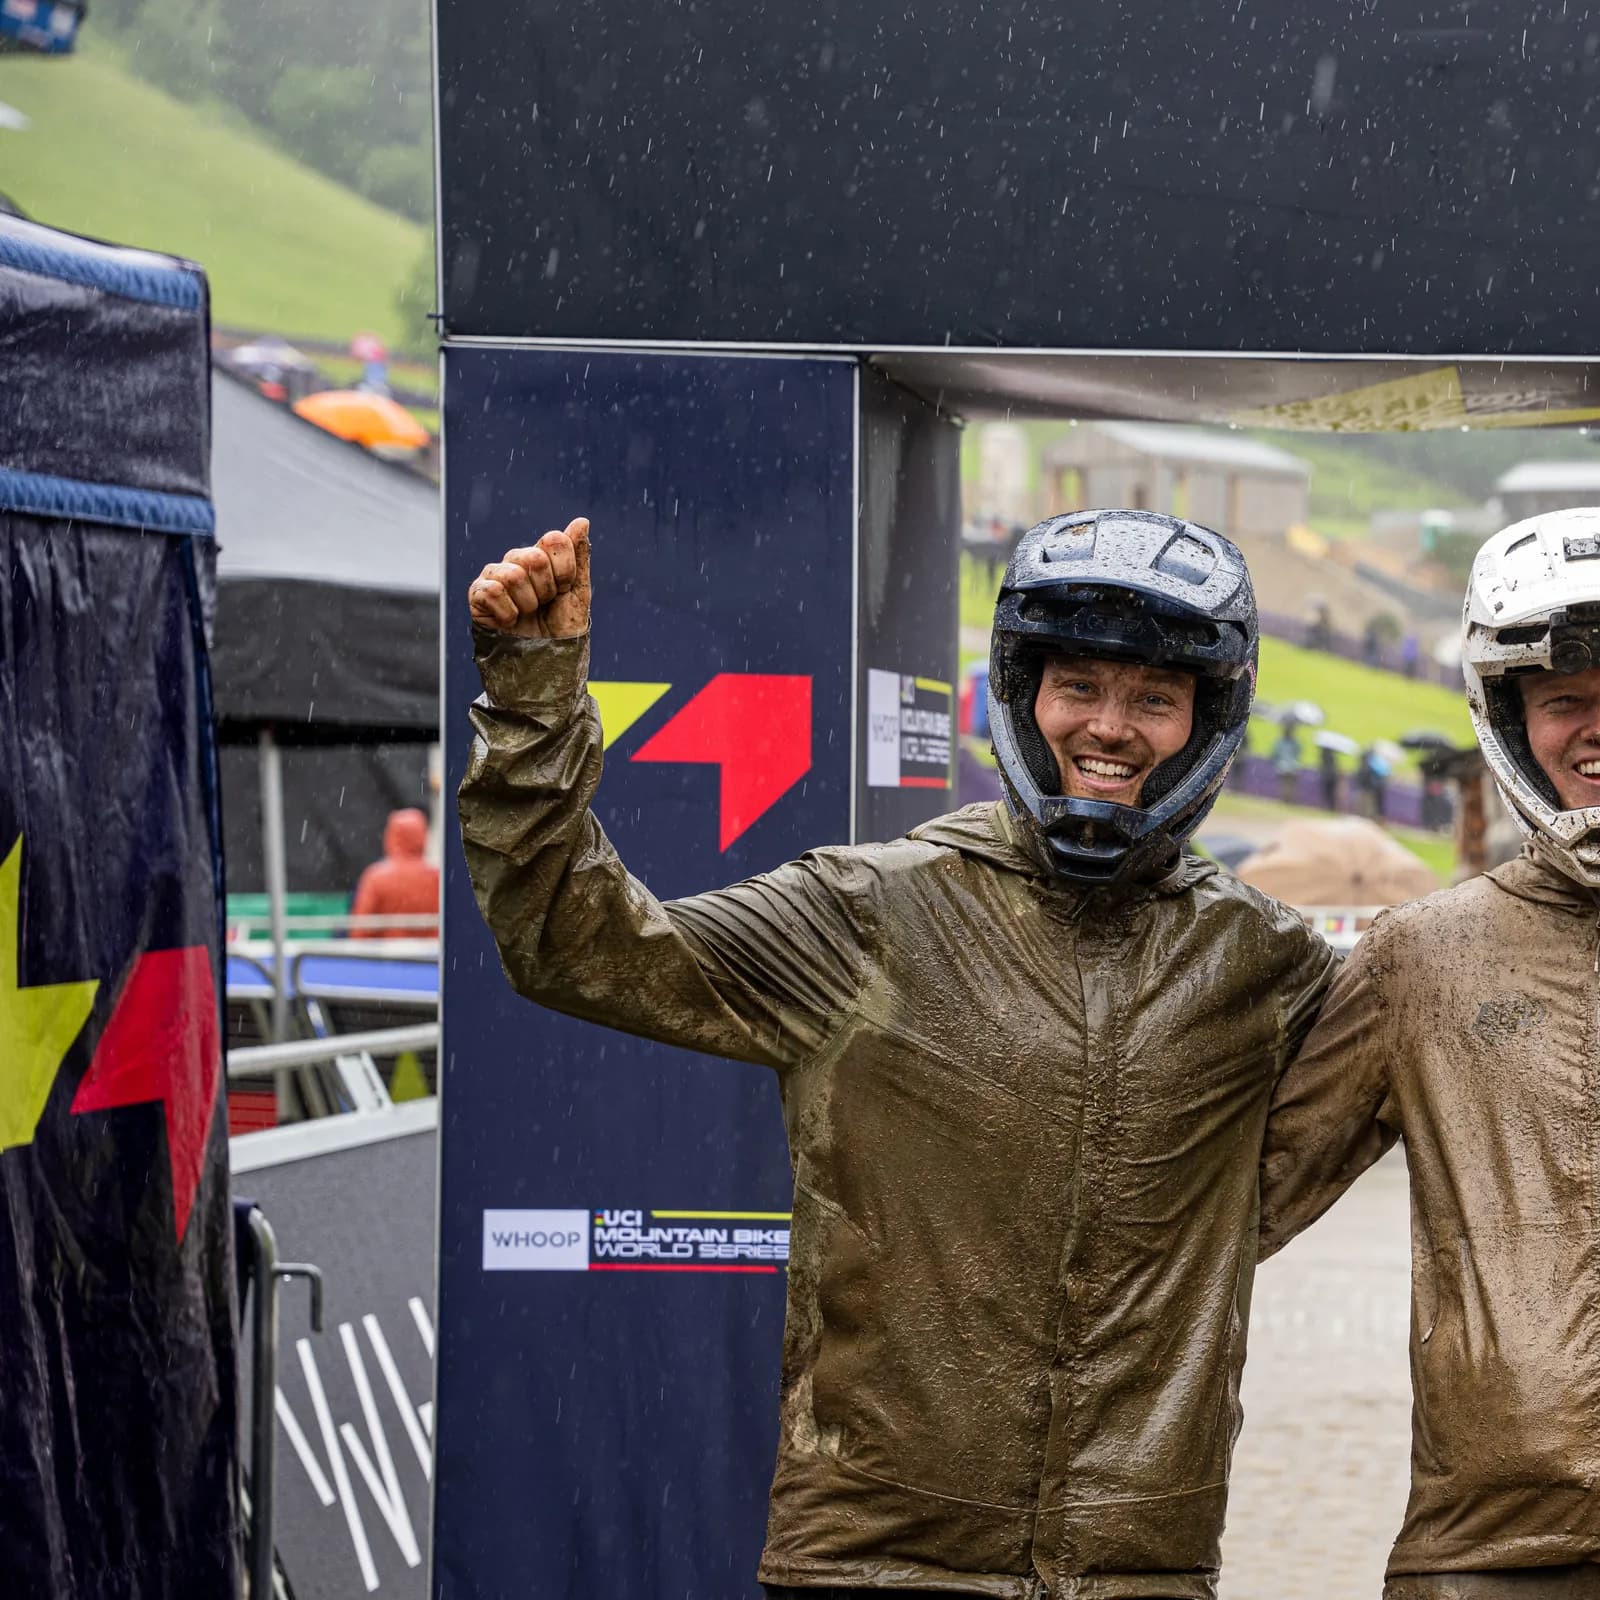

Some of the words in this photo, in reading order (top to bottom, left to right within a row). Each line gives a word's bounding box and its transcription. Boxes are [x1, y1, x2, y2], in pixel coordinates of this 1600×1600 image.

[604, 1210, 642, 1227] UCI
[492, 1231, 581, 1248] WHOOP
[595, 1227, 727, 1243] MOUNTAIN
[733, 1230, 790, 1244] BIKE
[595, 1243, 693, 1258] WORLD
[699, 1244, 790, 1259] SERIES
